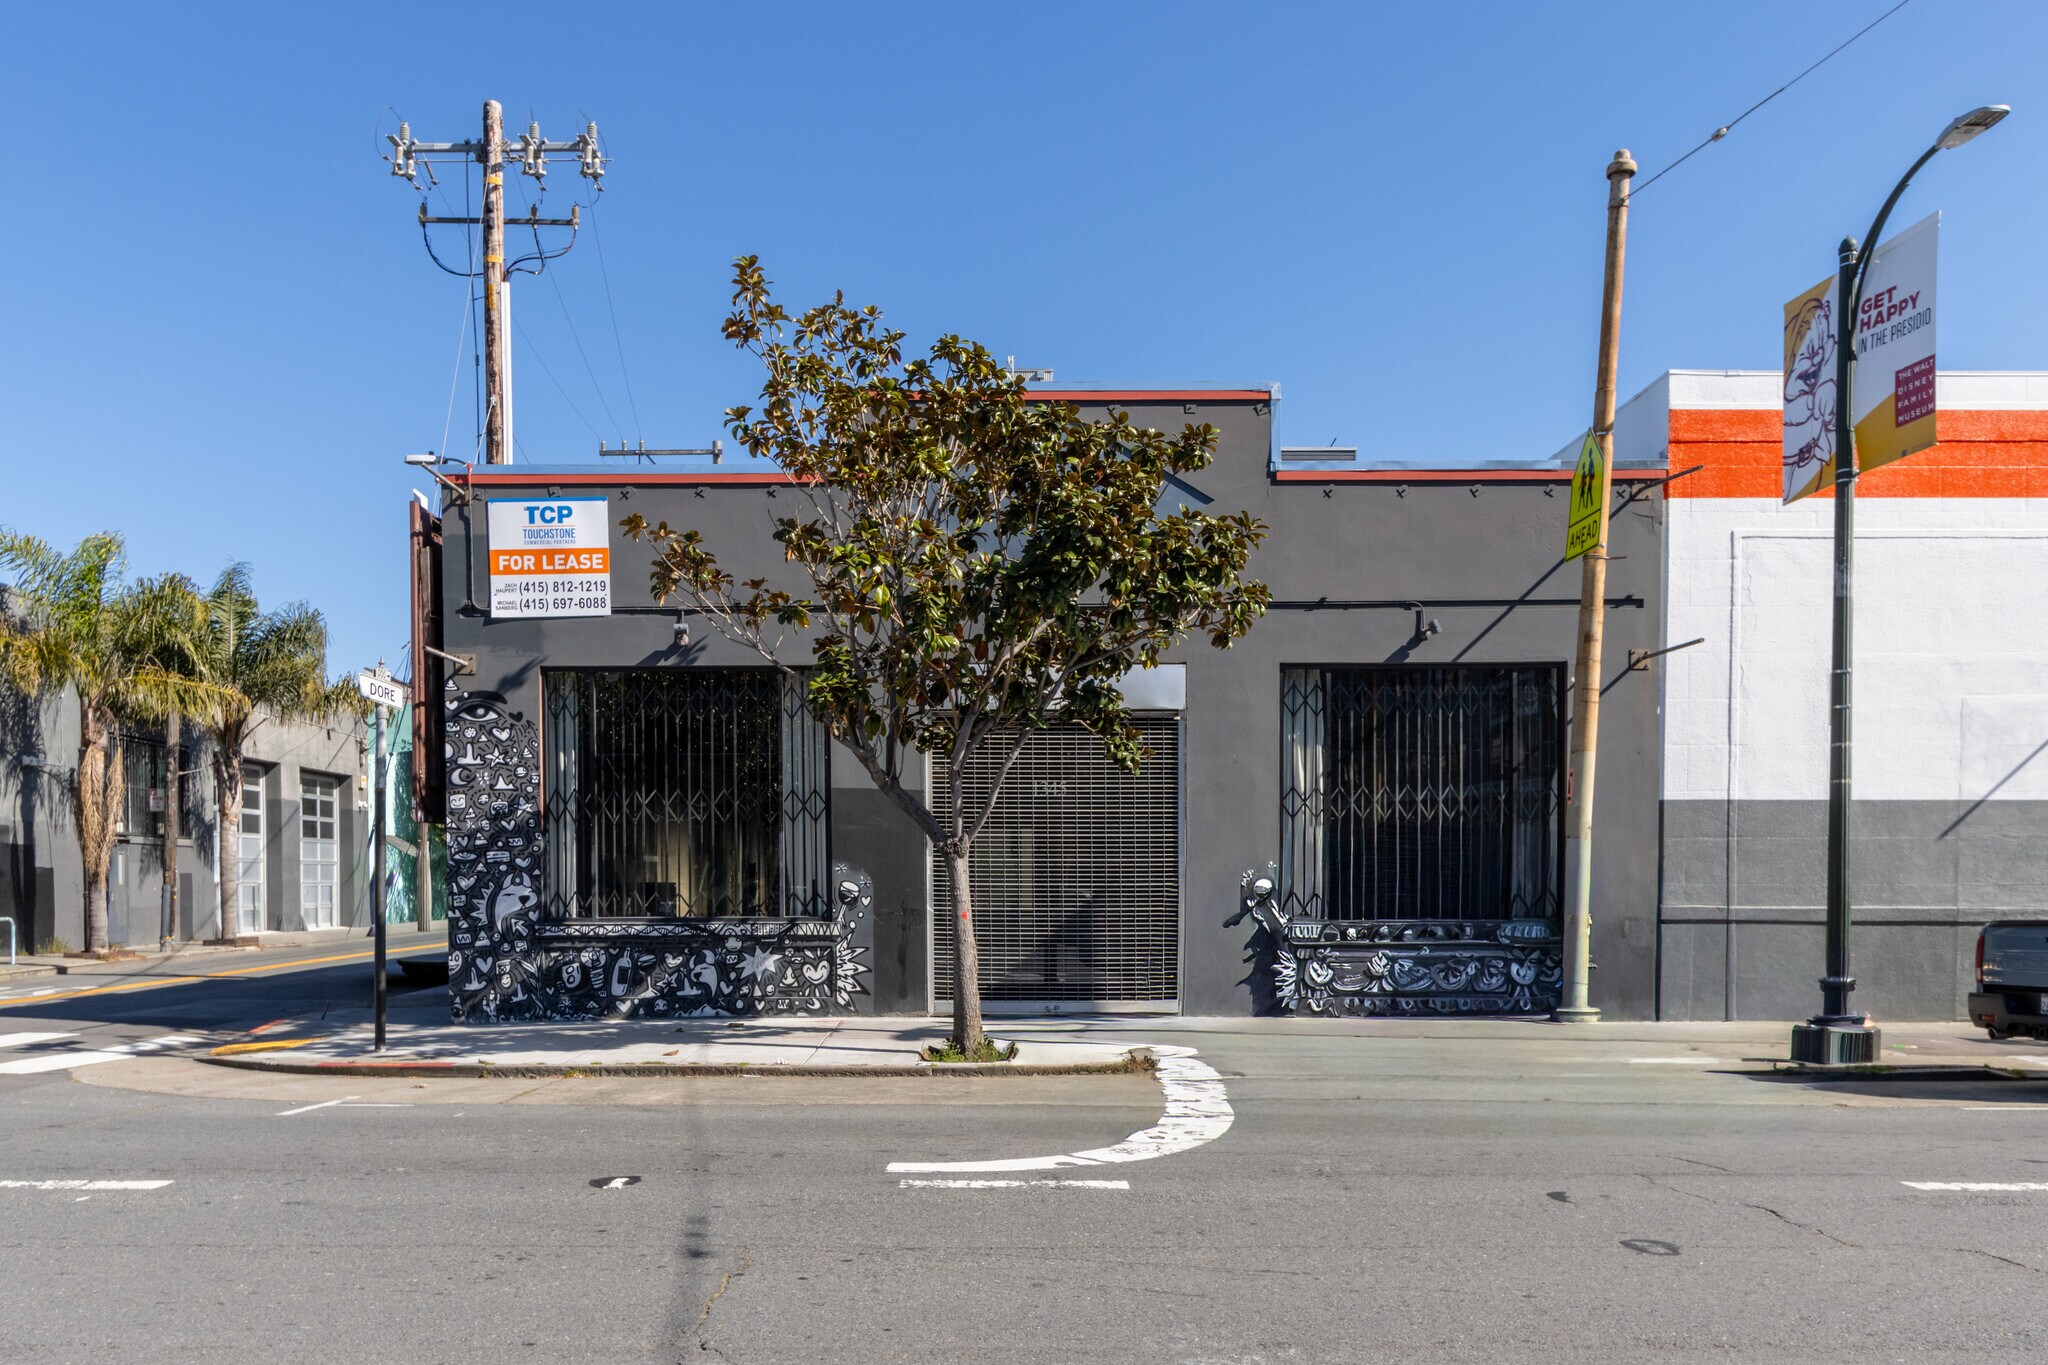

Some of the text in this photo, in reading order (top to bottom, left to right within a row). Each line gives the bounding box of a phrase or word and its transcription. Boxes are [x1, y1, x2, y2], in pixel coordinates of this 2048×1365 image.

[1861, 285, 1897, 315] GET
[1860, 290, 1920, 334] HAPPY
[1859, 307, 1931, 354] IN THE PRESIDIO
[1898, 359, 1934, 381] THE WALT
[1898, 374, 1934, 396] DISNEY
[1898, 388, 1934, 409] FAMILY
[1898, 402, 1934, 424] MUSEUM
[524, 505, 573, 524] TCP
[523, 528, 576, 540] TOUCHSTONE
[1569, 519, 1598, 551] AHEAD
[498, 554, 603, 571] FOR LEASE
[519, 580, 607, 596] (415) 812-1219
[519, 597, 607, 613] (415) 697-6088
[370, 683, 395, 702] DORE
[1032, 780, 1067, 796] 1345
